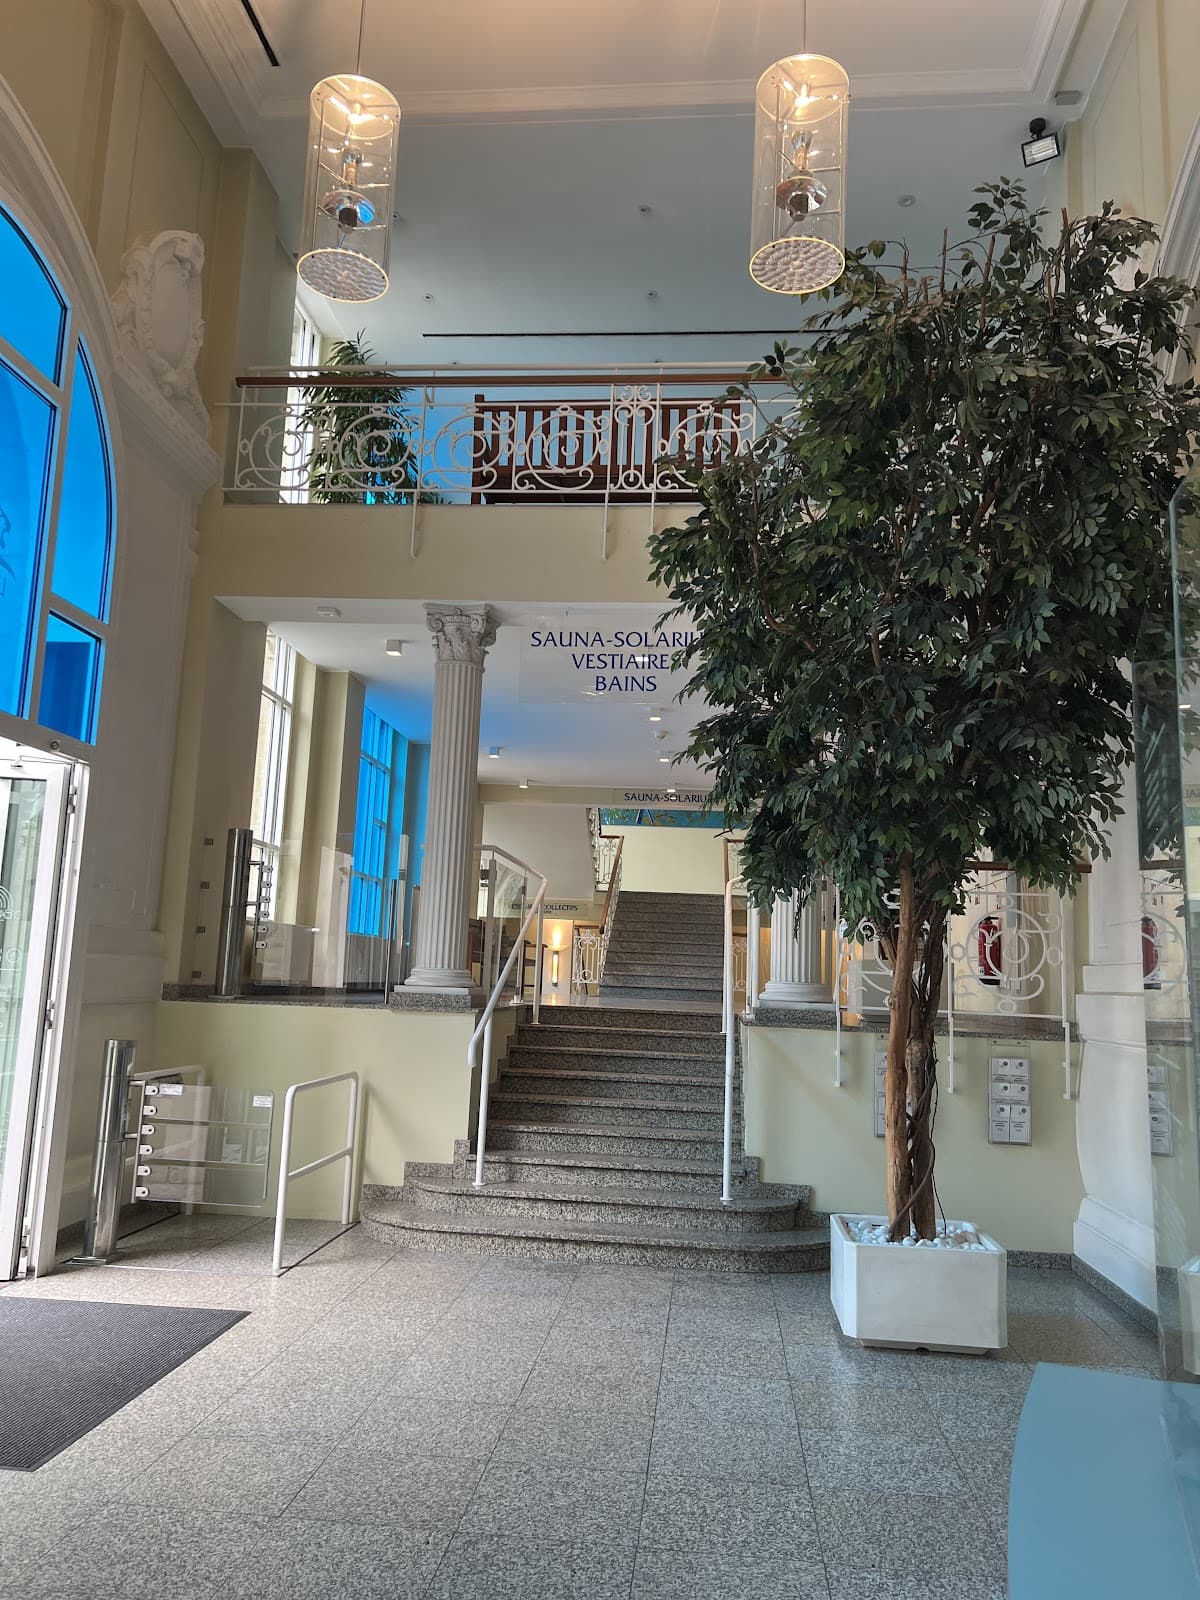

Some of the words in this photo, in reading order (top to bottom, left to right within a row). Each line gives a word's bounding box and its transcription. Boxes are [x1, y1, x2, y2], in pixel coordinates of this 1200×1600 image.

[530, 631, 704, 648] SAUNA-SOLARIU
[595, 675, 657, 692] BAINS
[624, 792, 707, 803] SAUNA-SOLARIU
